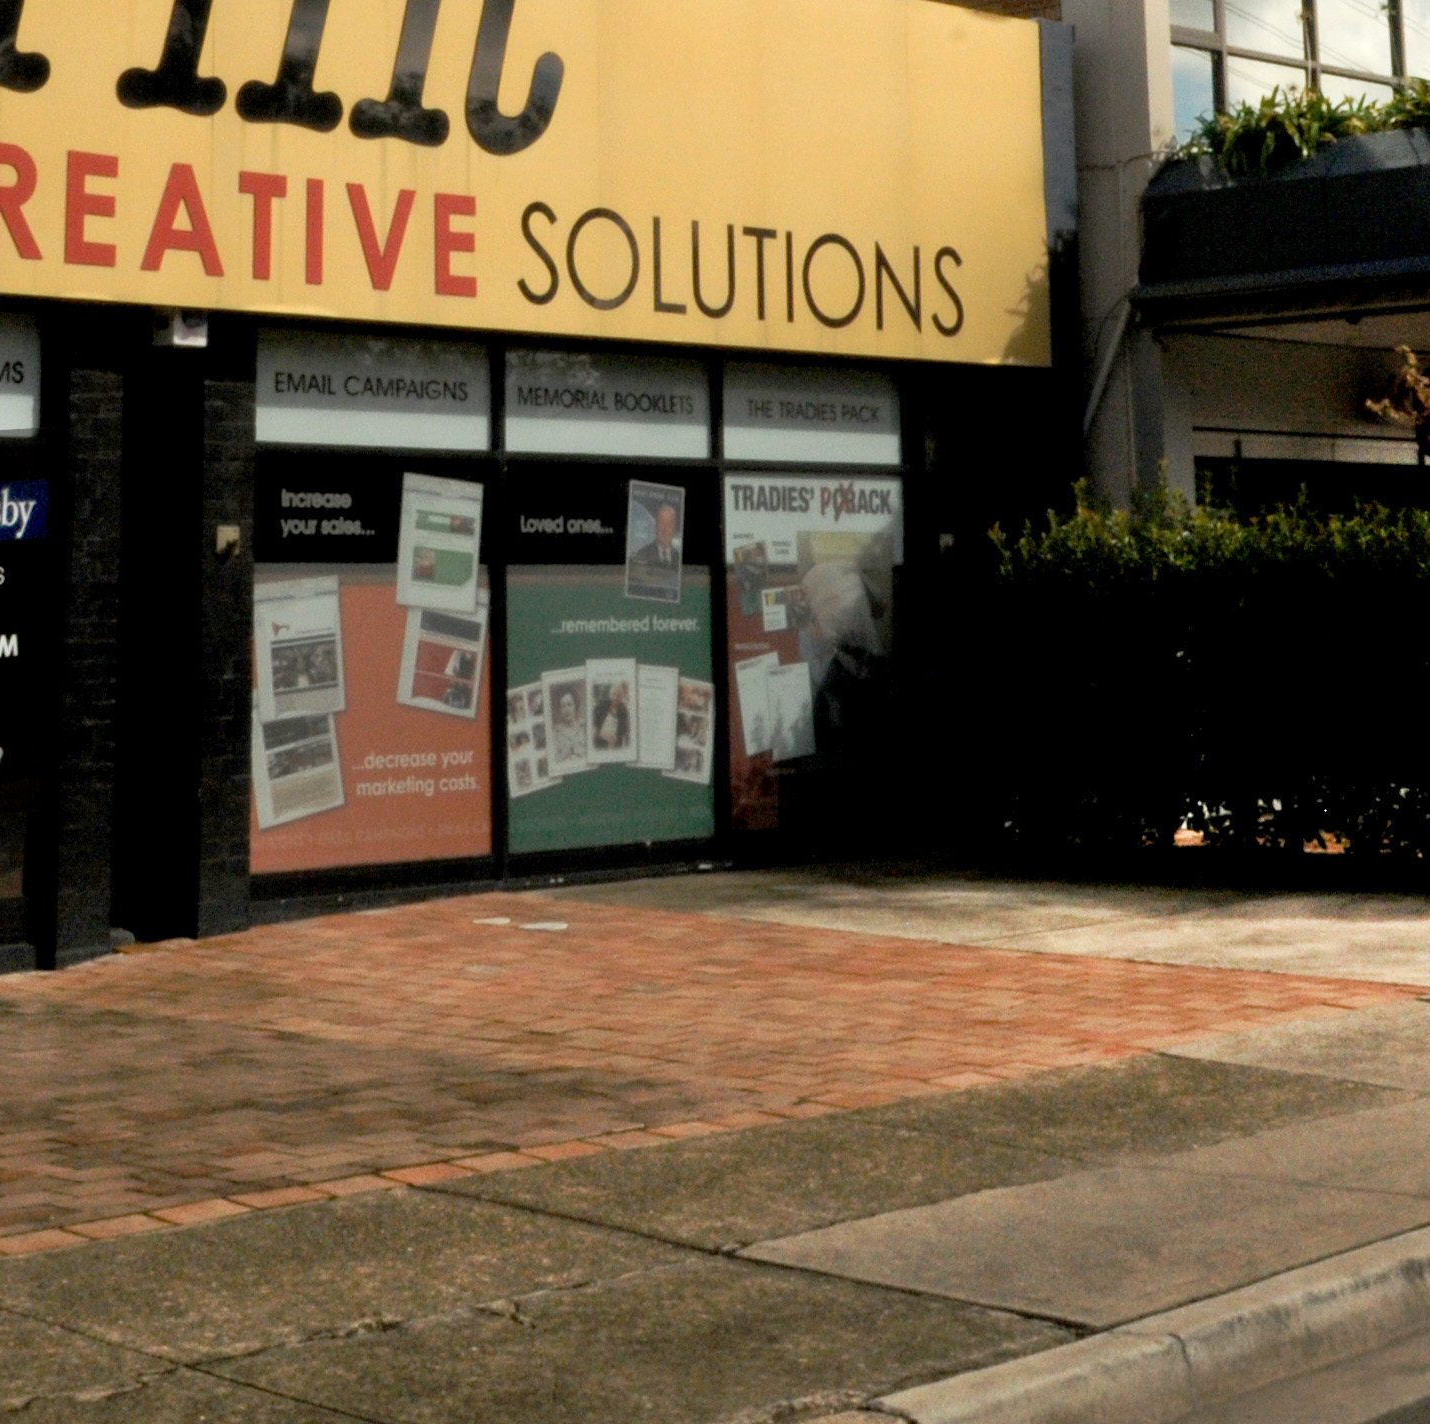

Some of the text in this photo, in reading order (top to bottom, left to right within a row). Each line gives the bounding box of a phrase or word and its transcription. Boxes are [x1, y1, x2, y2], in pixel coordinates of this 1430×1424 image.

[516, 200, 965, 337] SOLUTIONS
[274, 372, 469, 403] EMAIL CAMPAIGNS
[517, 386, 694, 416] MEMORIAL BOOKLETS
[747, 398, 880, 424] THE TRADIES PACK
[281, 488, 353, 509] Increase
[731, 484, 815, 513] TRADIES'
[280, 518, 319, 538] your
[520, 514, 564, 534] Loved
[441, 750, 475, 770] your
[356, 776, 436, 797] marketing
